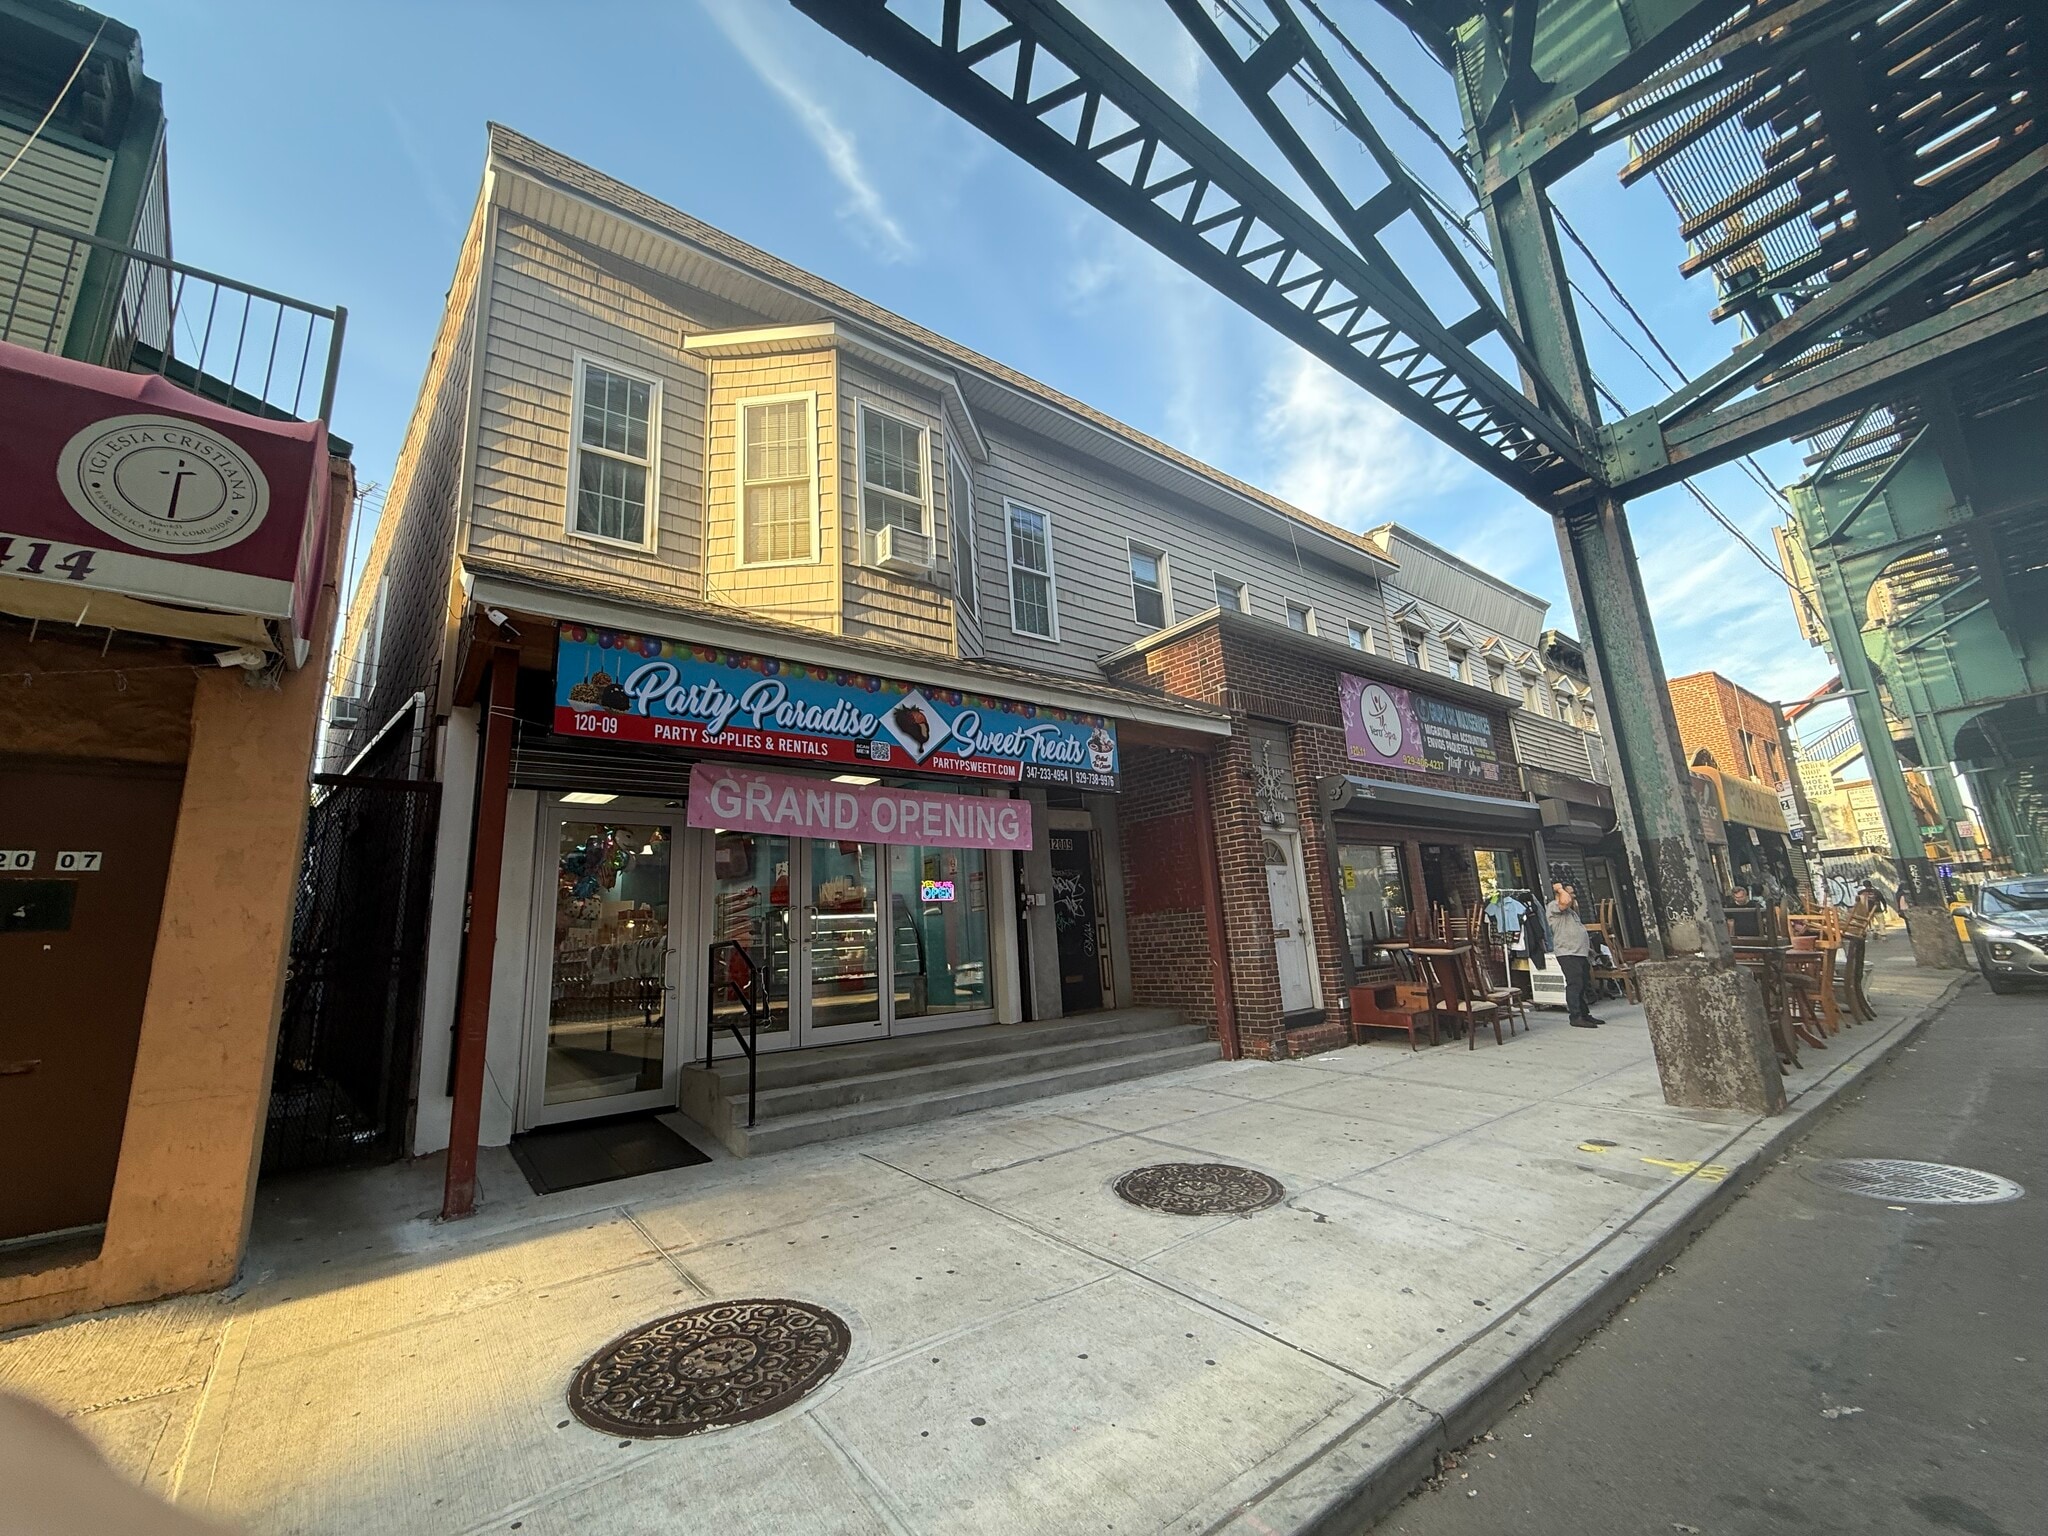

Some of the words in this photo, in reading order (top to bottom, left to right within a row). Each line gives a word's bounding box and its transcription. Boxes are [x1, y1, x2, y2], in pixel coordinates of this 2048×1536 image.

[88, 431, 155, 475] IGLESIA
[163, 432, 246, 500] CRISTIANA
[165, 529, 180, 537] LA
[181, 515, 235, 538] COMUNIDAD
[574, 713, 618, 734] 120-09
[624, 661, 739, 736] Party
[740, 679, 880, 738] Paradise
[951, 710, 1028, 759] Sweet
[1022, 723, 1085, 764] Treats
[654, 724, 698, 742] PARTY
[701, 729, 762, 749] SUPPLIES
[765, 736, 775, 751] &
[778, 738, 828, 757] RENTALS
[1383, 723, 1397, 746] Spa
[933, 756, 1016, 777] PARTYPSWEETT.COM
[1026, 765, 1069, 783] 347-233-4954
[1075, 772, 1115, 787] 929-738-9976
[709, 778, 859, 829] GRAND
[871, 796, 1020, 840] OPENING
[1781, 801, 1789, 810] 2
[60, 854, 98, 869] 07
[921, 880, 934, 889] YES
[923, 887, 953, 900] OPEN
